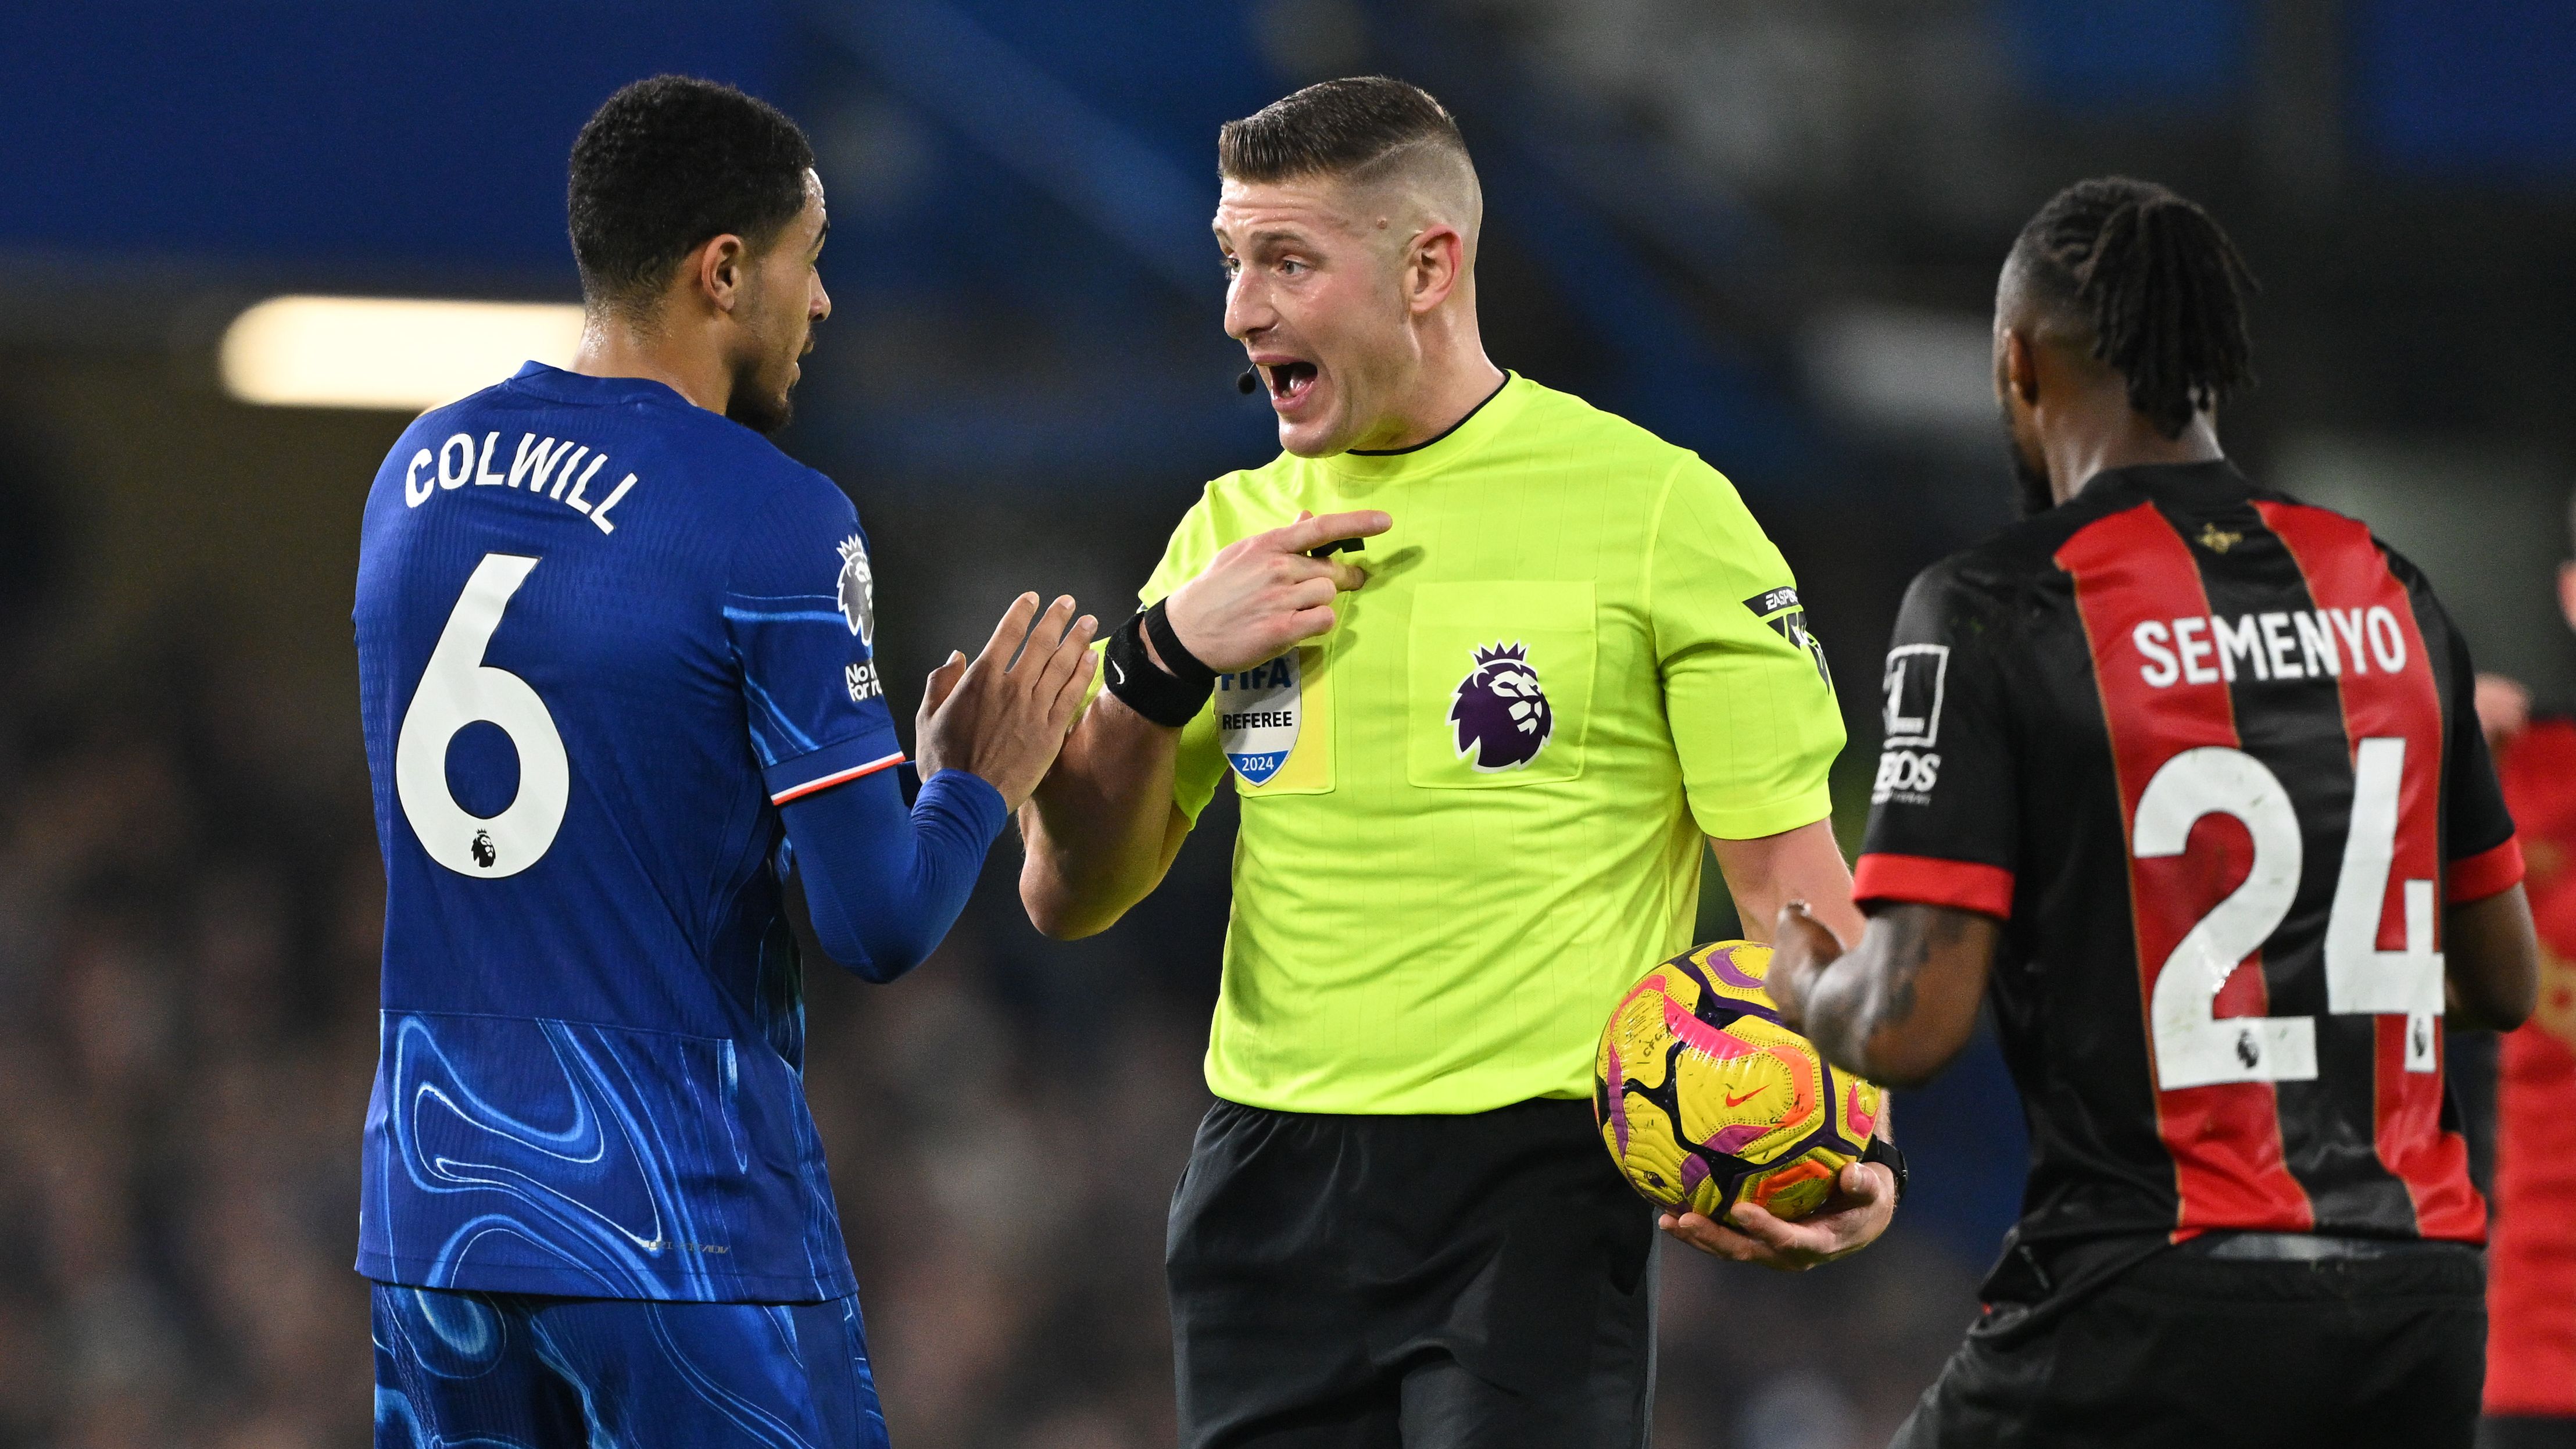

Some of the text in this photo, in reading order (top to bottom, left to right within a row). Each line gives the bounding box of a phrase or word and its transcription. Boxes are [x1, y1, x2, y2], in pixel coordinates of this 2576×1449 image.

[405, 431, 638, 535] COLWILL
[845, 663, 868, 683] No
[2133, 606, 2406, 688] SEMENYO
[396, 553, 570, 878] 6
[1222, 711, 1293, 729] REFEREE
[1242, 756, 1274, 771] 2024
[2133, 738, 2445, 1090] 24
